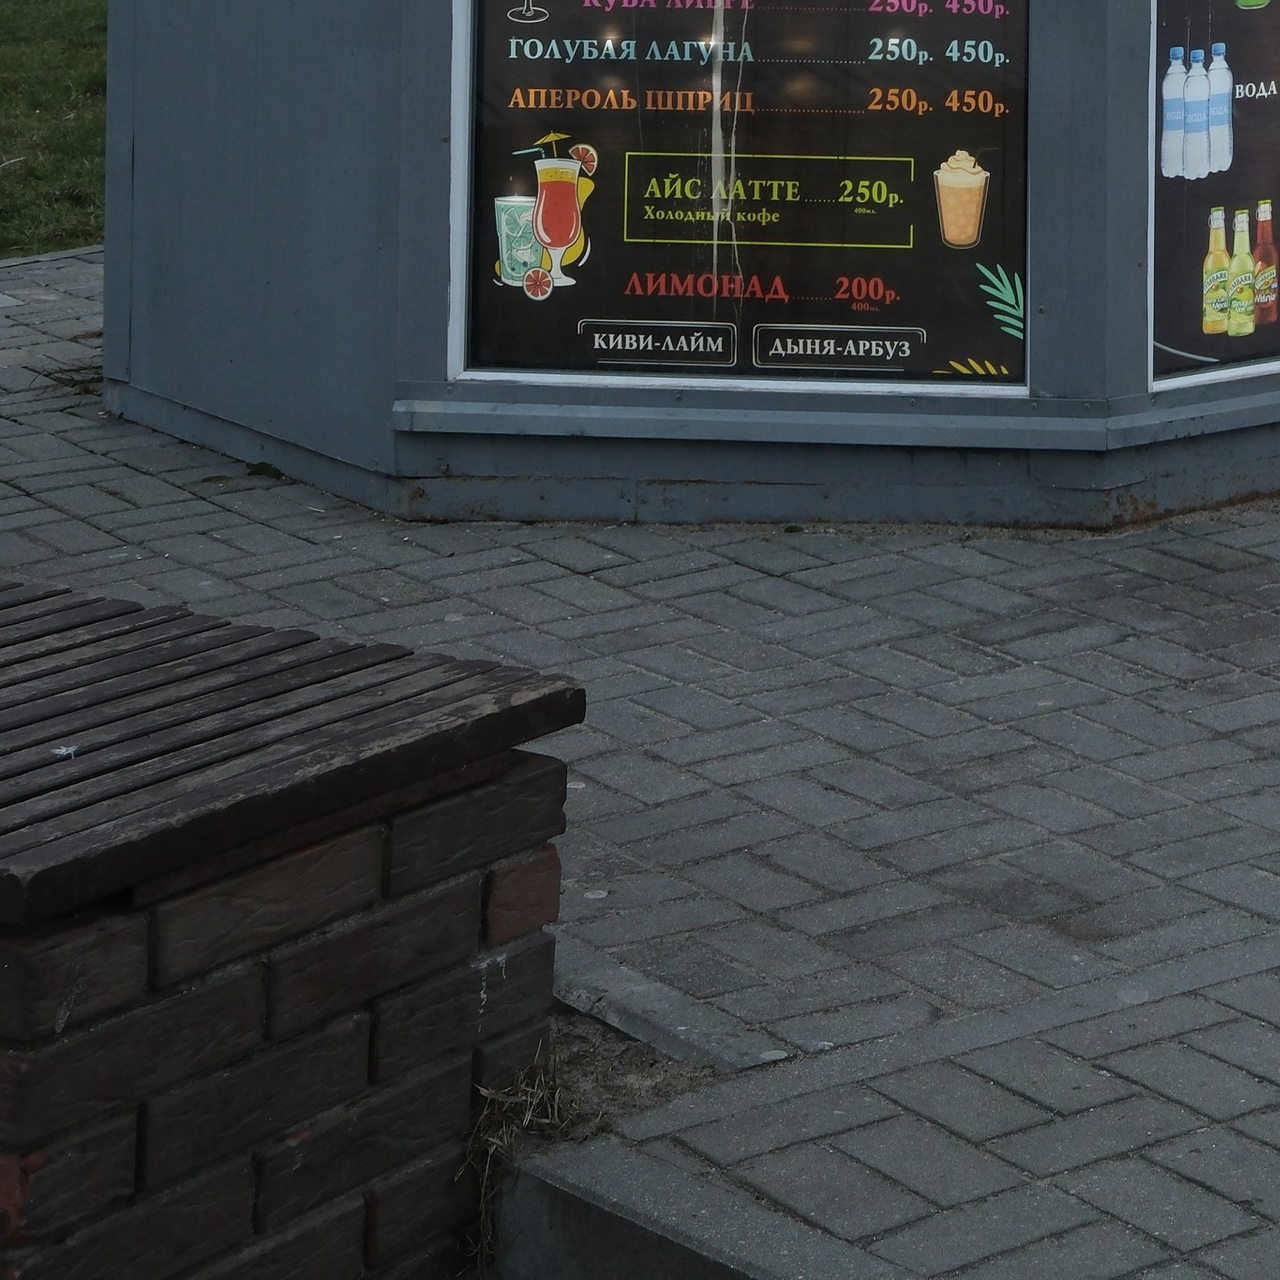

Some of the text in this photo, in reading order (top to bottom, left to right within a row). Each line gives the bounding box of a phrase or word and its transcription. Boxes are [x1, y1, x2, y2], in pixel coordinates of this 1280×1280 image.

[509, 38, 637, 63] ГОЛУБАЯ
[645, 40, 754, 65] ЛАГУНА
[508, 88, 637, 110] АПЕРОЛЬ
[645, 90, 755, 115] ШПРИЦ
[1235, 81, 1278, 99] ВОДА
[644, 173, 701, 200] АЙС
[711, 178, 800, 202] ЛАТТЕ
[644, 206, 780, 225] Холодный кофе
[624, 272, 789, 303] ЛИМОНАД
[593, 332, 724, 352] КИВИ-ЛАЙМ
[769, 338, 910, 359] ДЫНЯ-АРБУЗ
